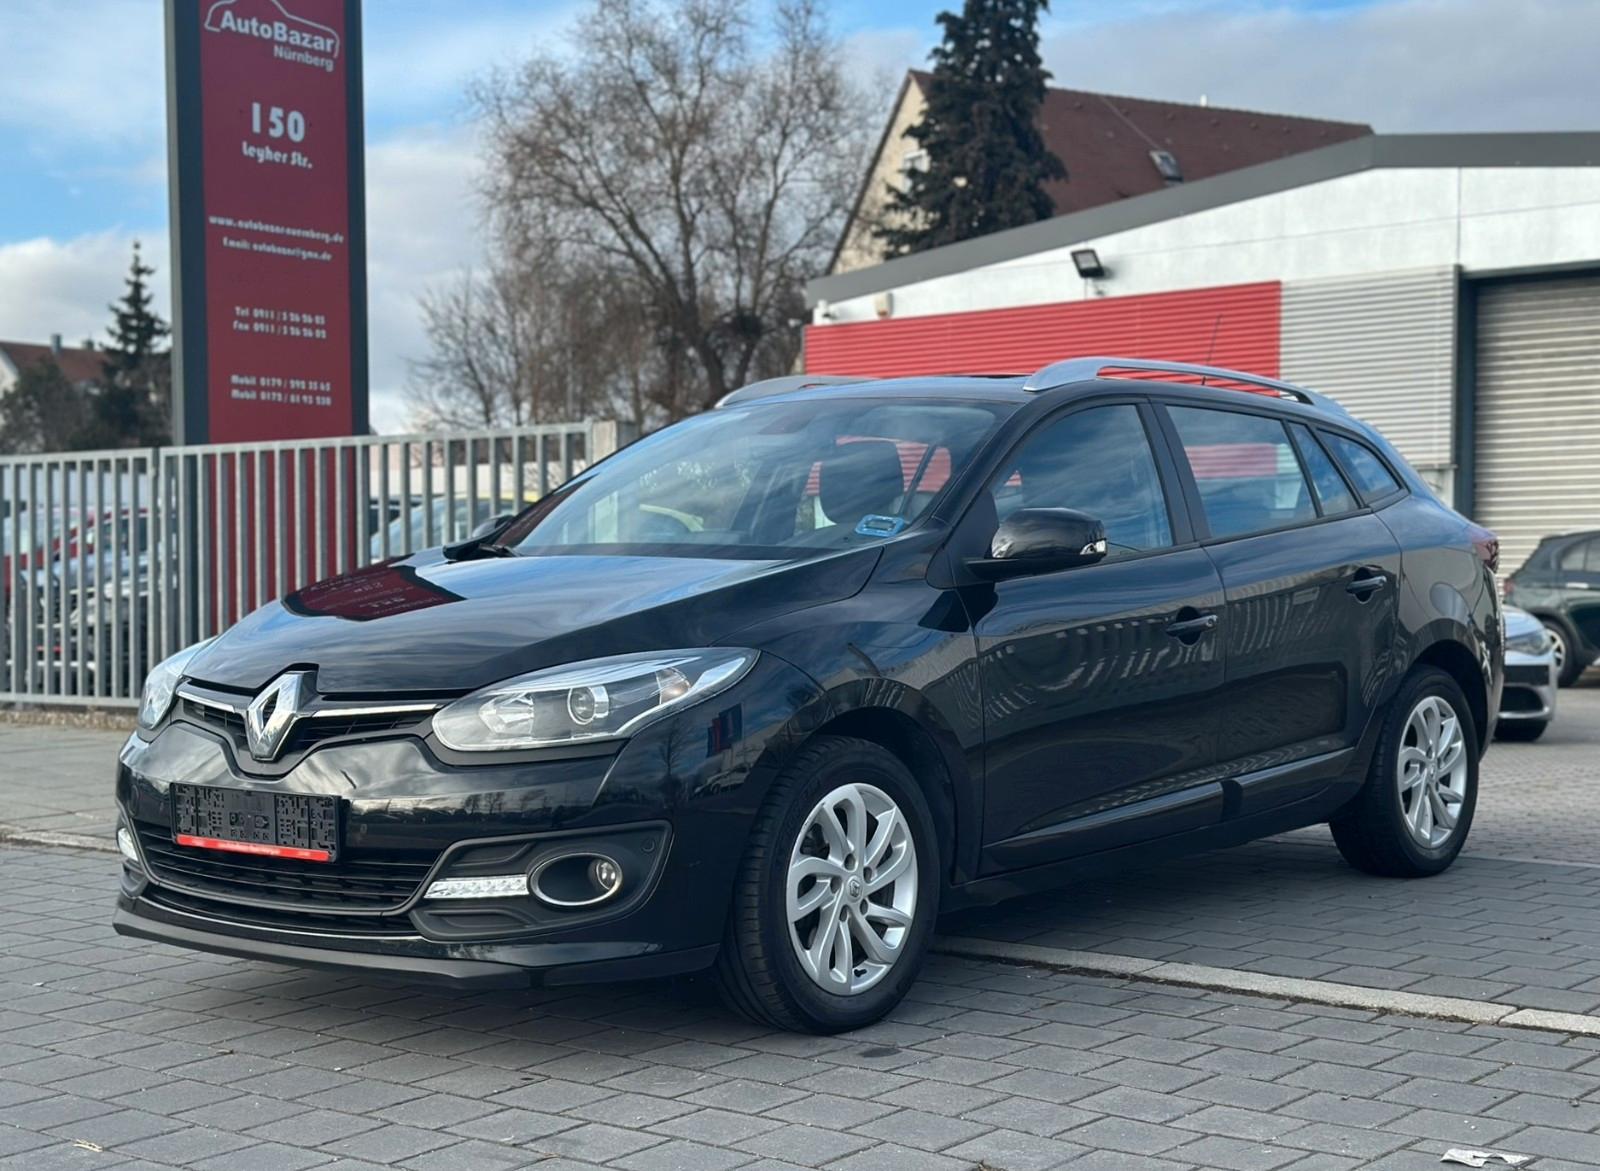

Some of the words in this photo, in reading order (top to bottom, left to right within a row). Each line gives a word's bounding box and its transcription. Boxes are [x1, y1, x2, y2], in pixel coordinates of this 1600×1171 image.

[221, 10, 335, 52] AutoBazar
[273, 45, 334, 72] Nürnberg
[242, 141, 288, 163] Leyher
[290, 151, 313, 169] Str.
